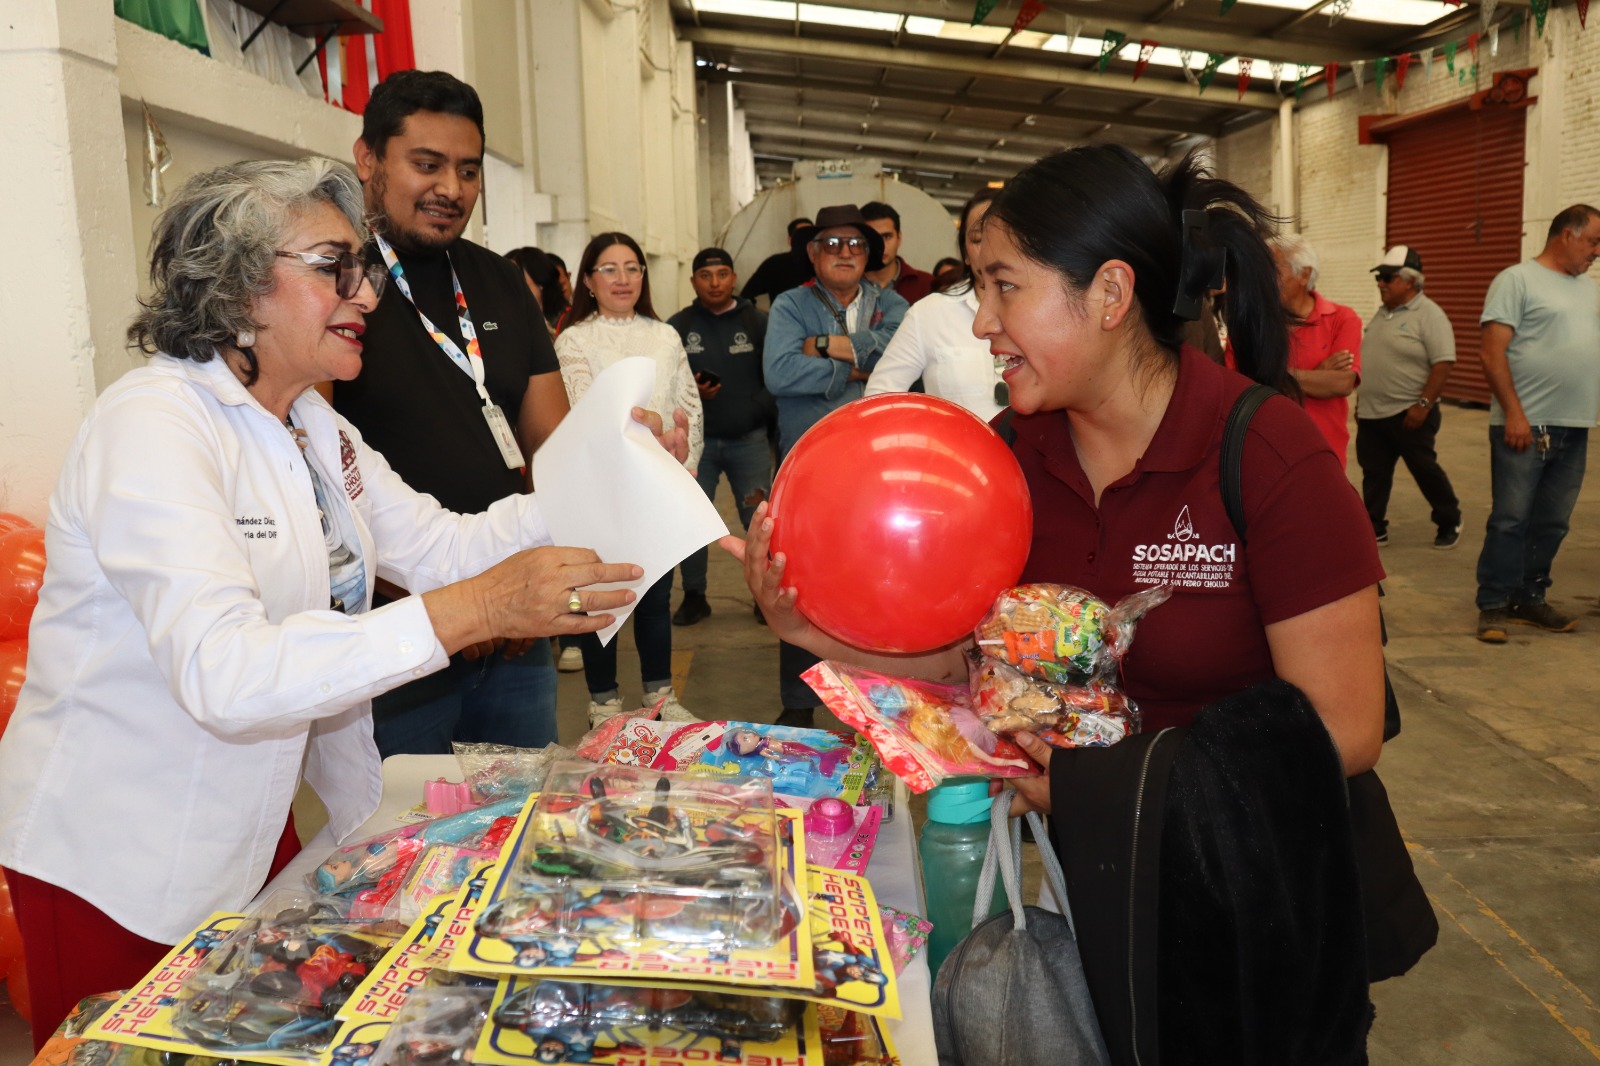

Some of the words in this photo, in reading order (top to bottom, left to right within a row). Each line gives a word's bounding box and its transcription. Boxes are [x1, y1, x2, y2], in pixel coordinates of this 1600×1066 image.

[256, 531, 267, 539] del
[1132, 543, 1236, 562] SOSAPACH
[1133, 563, 1153, 571] SISTEMA
[1153, 563, 1179, 571] OPERADOR
[1200, 564, 1226, 572] SERVICIOS
[1176, 572, 1223, 580] ALCANTARILLADO
[1223, 572, 1233, 580] DEL
[1203, 580, 1230, 588] CHOLULA
[844, 876, 875, 948] SUPER
[423, 906, 475, 965] SUPER
[355, 942, 426, 1014] SUPER
[598, 961, 799, 980] SUPER
[101, 954, 190, 1032] SUPER
[375, 967, 432, 1018] HERO
